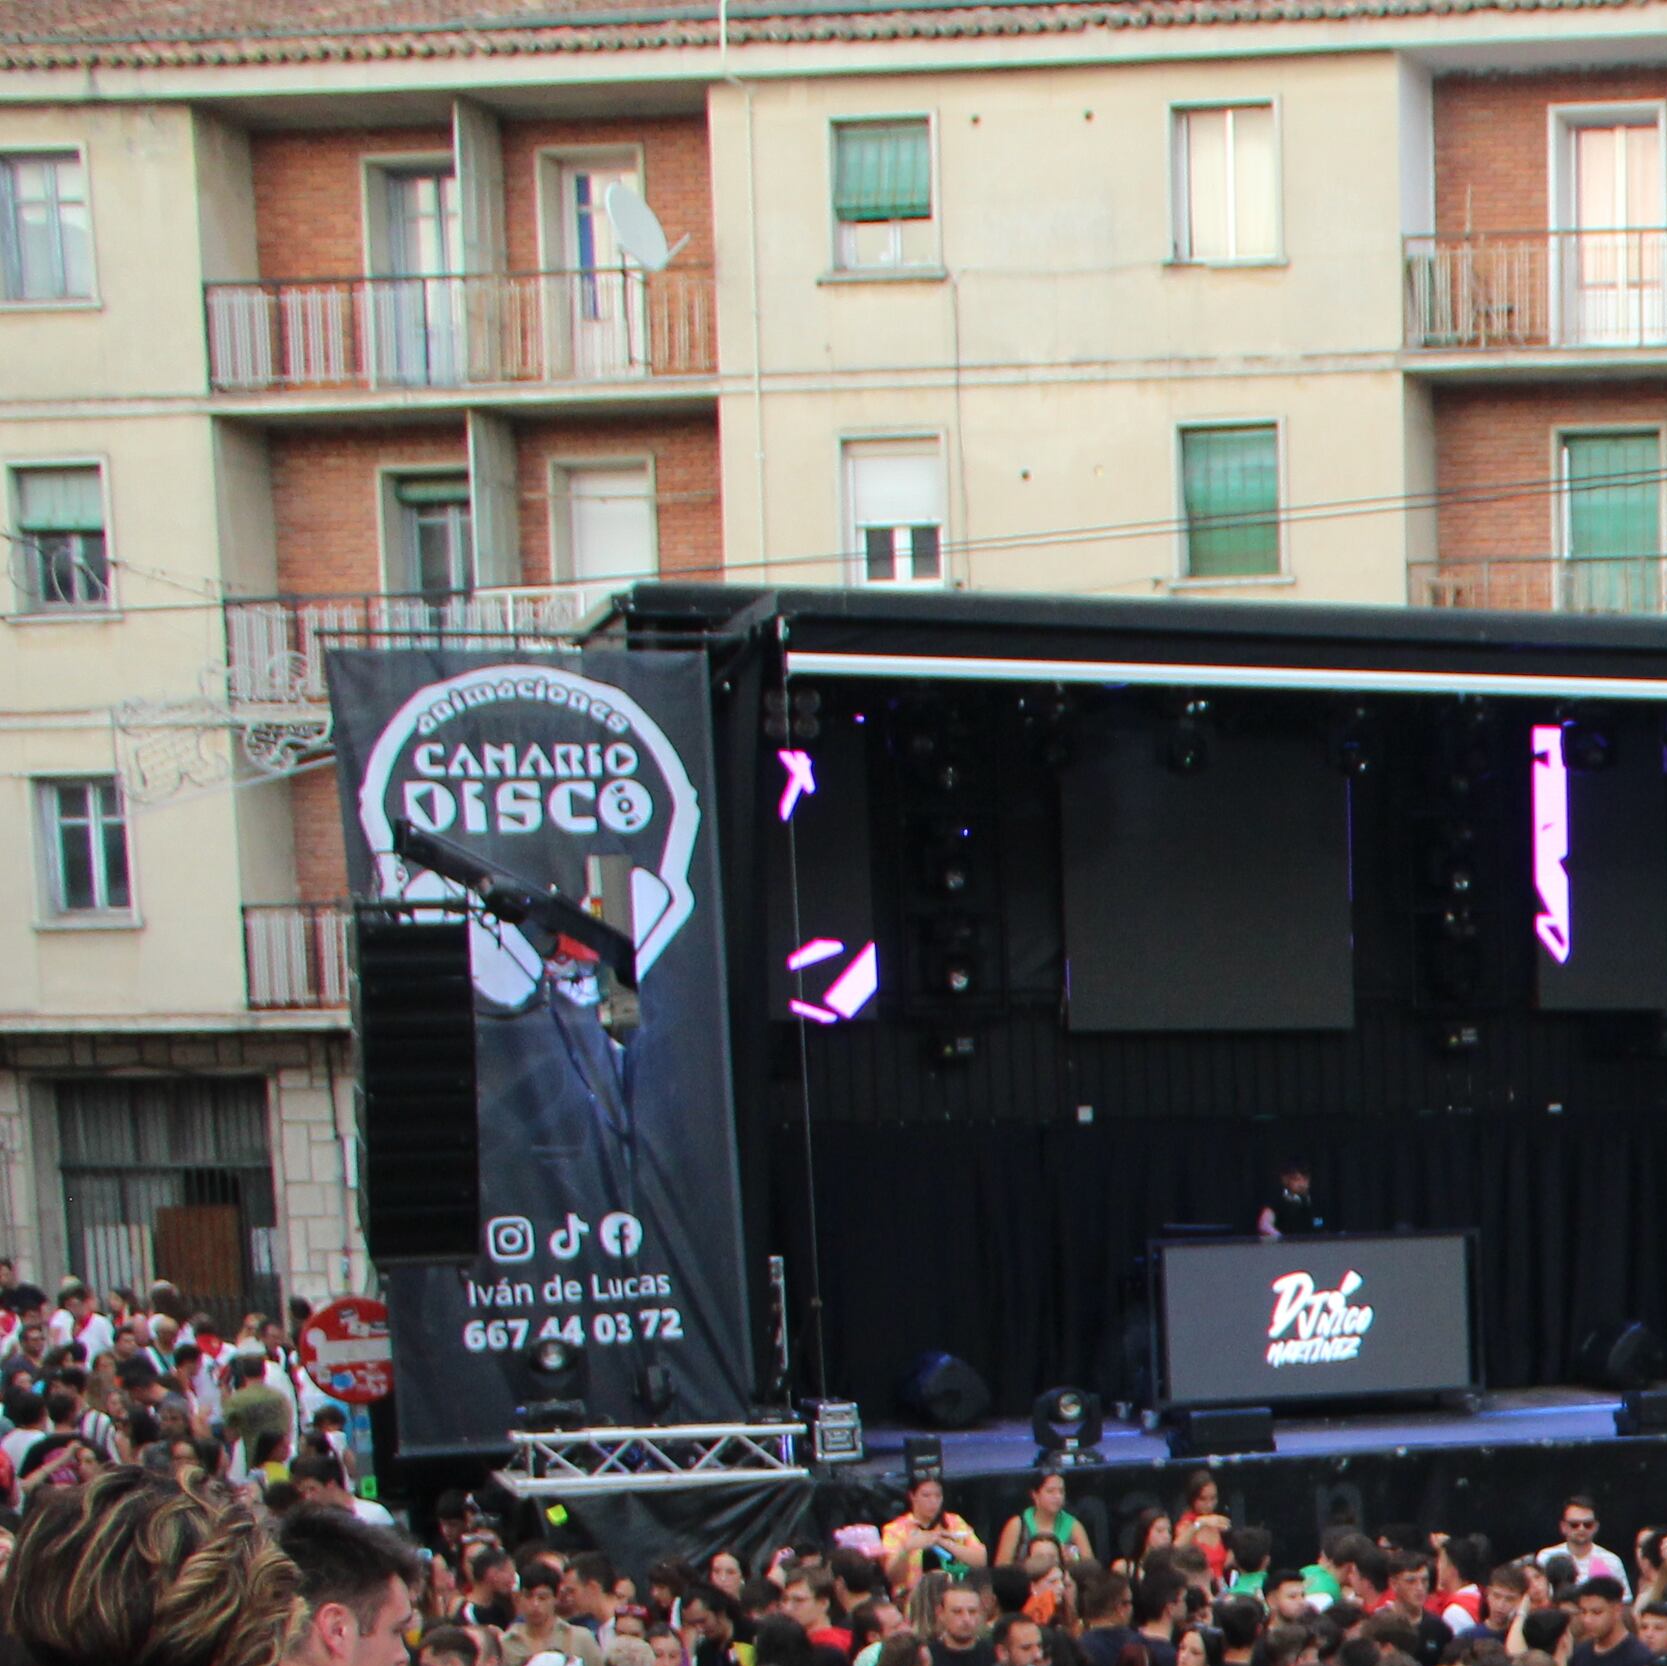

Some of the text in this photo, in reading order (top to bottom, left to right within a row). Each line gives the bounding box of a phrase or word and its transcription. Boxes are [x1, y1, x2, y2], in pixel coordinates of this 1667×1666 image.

[417, 678, 631, 736] animaciones
[413, 741, 640, 779] CANARIO
[403, 777, 655, 835] DISCO
[466, 1272, 672, 1307] Iván de Lucas
[463, 1308, 684, 1352] 667 44 03 72
